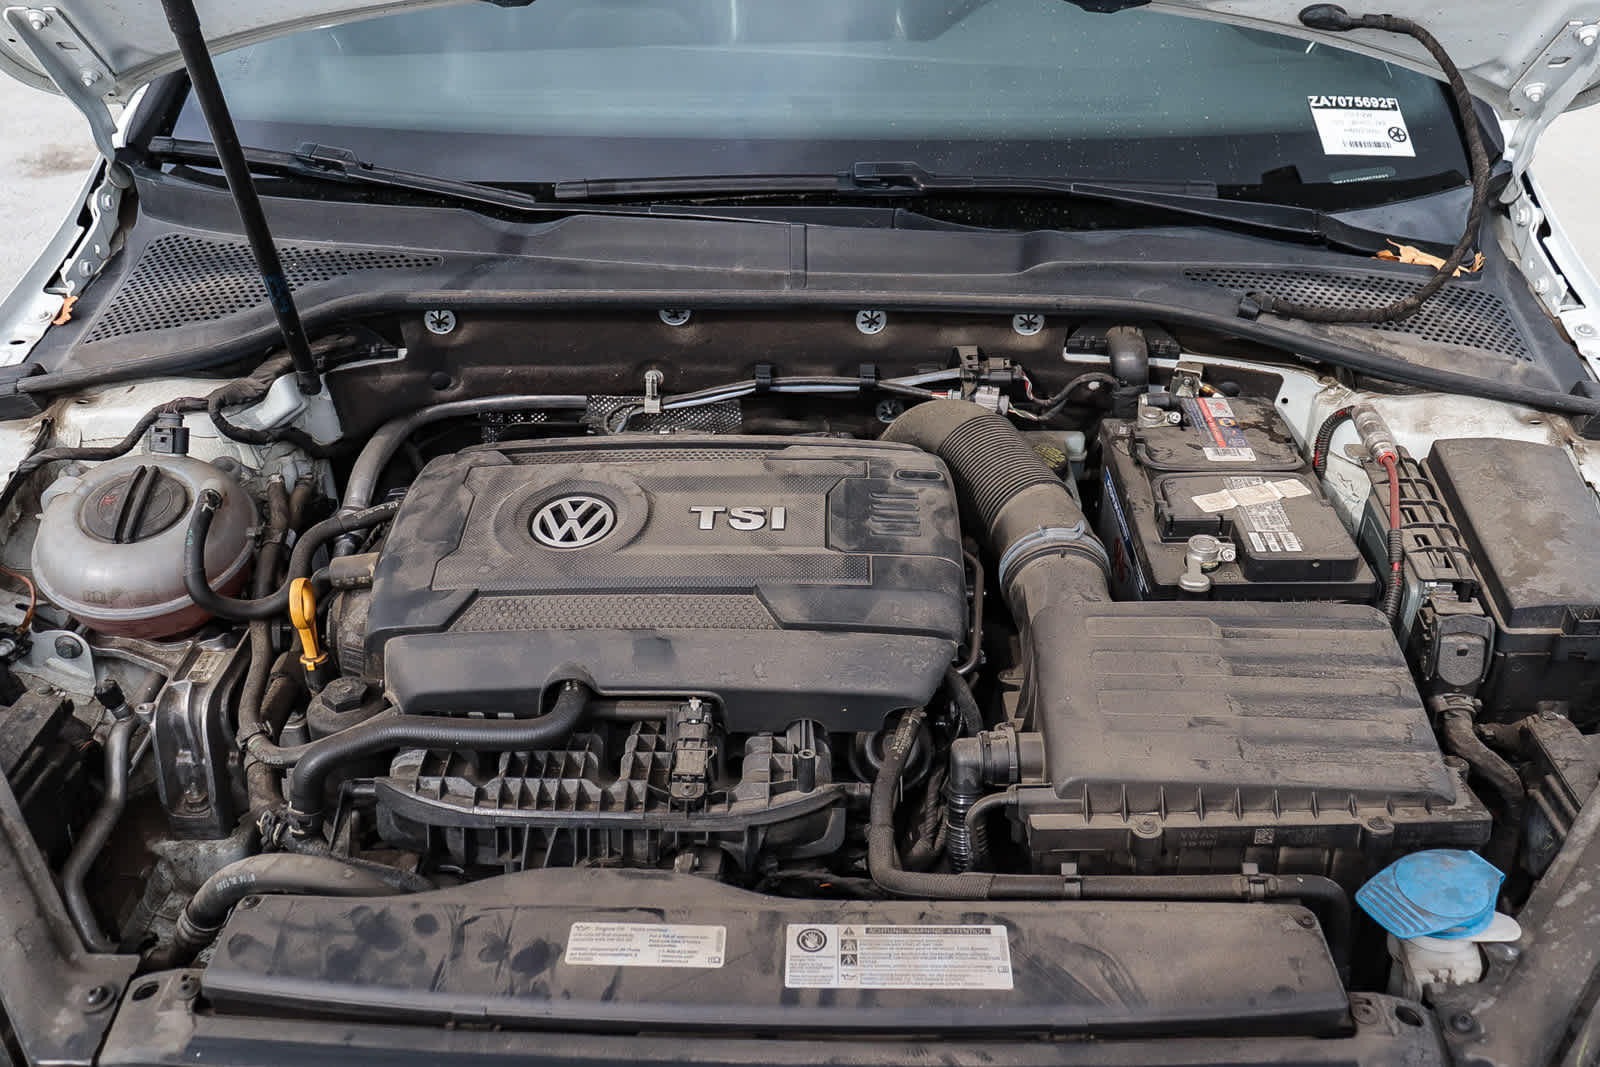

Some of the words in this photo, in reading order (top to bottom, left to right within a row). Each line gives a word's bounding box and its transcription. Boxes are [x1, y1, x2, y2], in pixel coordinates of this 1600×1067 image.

[1308, 96, 1395, 109] ZA7075692F
[532, 496, 615, 549] VW
[690, 506, 787, 531] TSI
